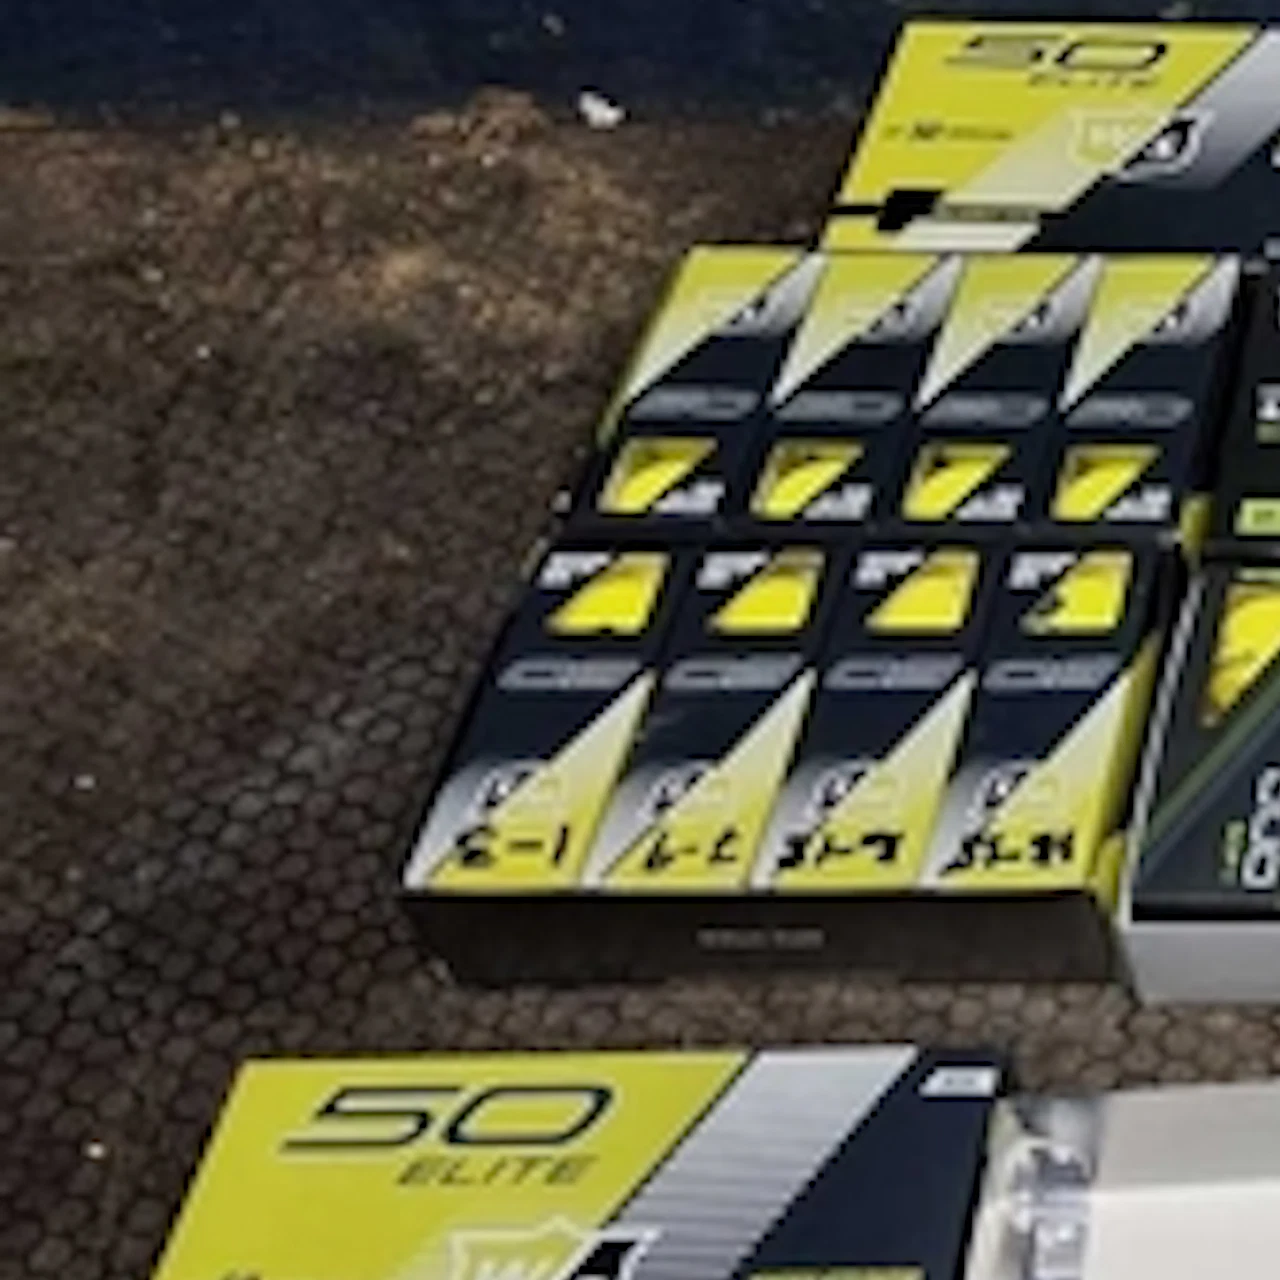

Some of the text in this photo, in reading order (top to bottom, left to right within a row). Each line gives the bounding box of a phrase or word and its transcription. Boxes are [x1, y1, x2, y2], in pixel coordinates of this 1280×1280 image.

[944, 31, 1168, 70] 50
[278, 1084, 616, 1153] 50
[397, 1154, 597, 1187] ELITE
